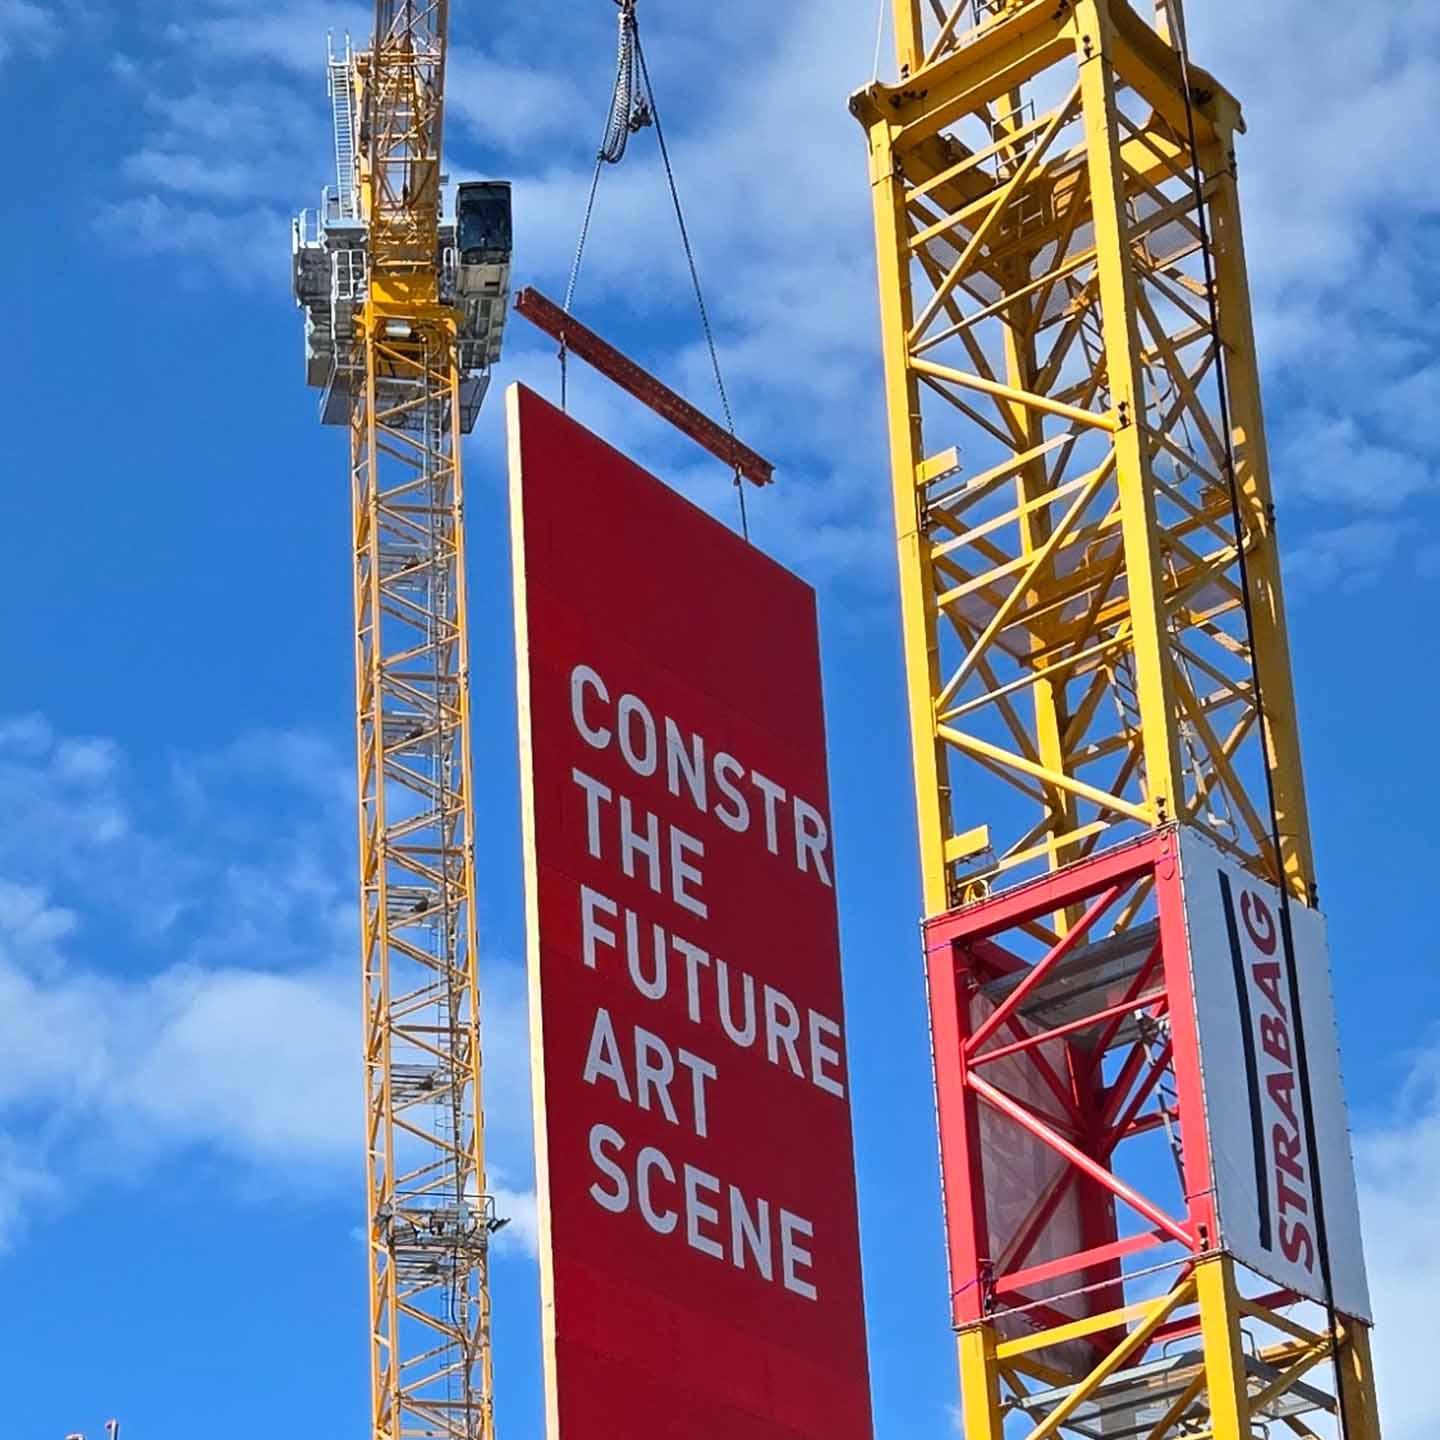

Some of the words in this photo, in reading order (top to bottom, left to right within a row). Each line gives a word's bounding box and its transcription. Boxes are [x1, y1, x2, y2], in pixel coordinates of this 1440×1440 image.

[570, 664, 832, 887] CONSTR
[572, 767, 708, 920] THE
[580, 883, 844, 1099] FUTURE
[583, 1007, 717, 1139] ART
[1240, 888, 1313, 1274] STRABAG
[588, 1123, 817, 1300] SCENE
